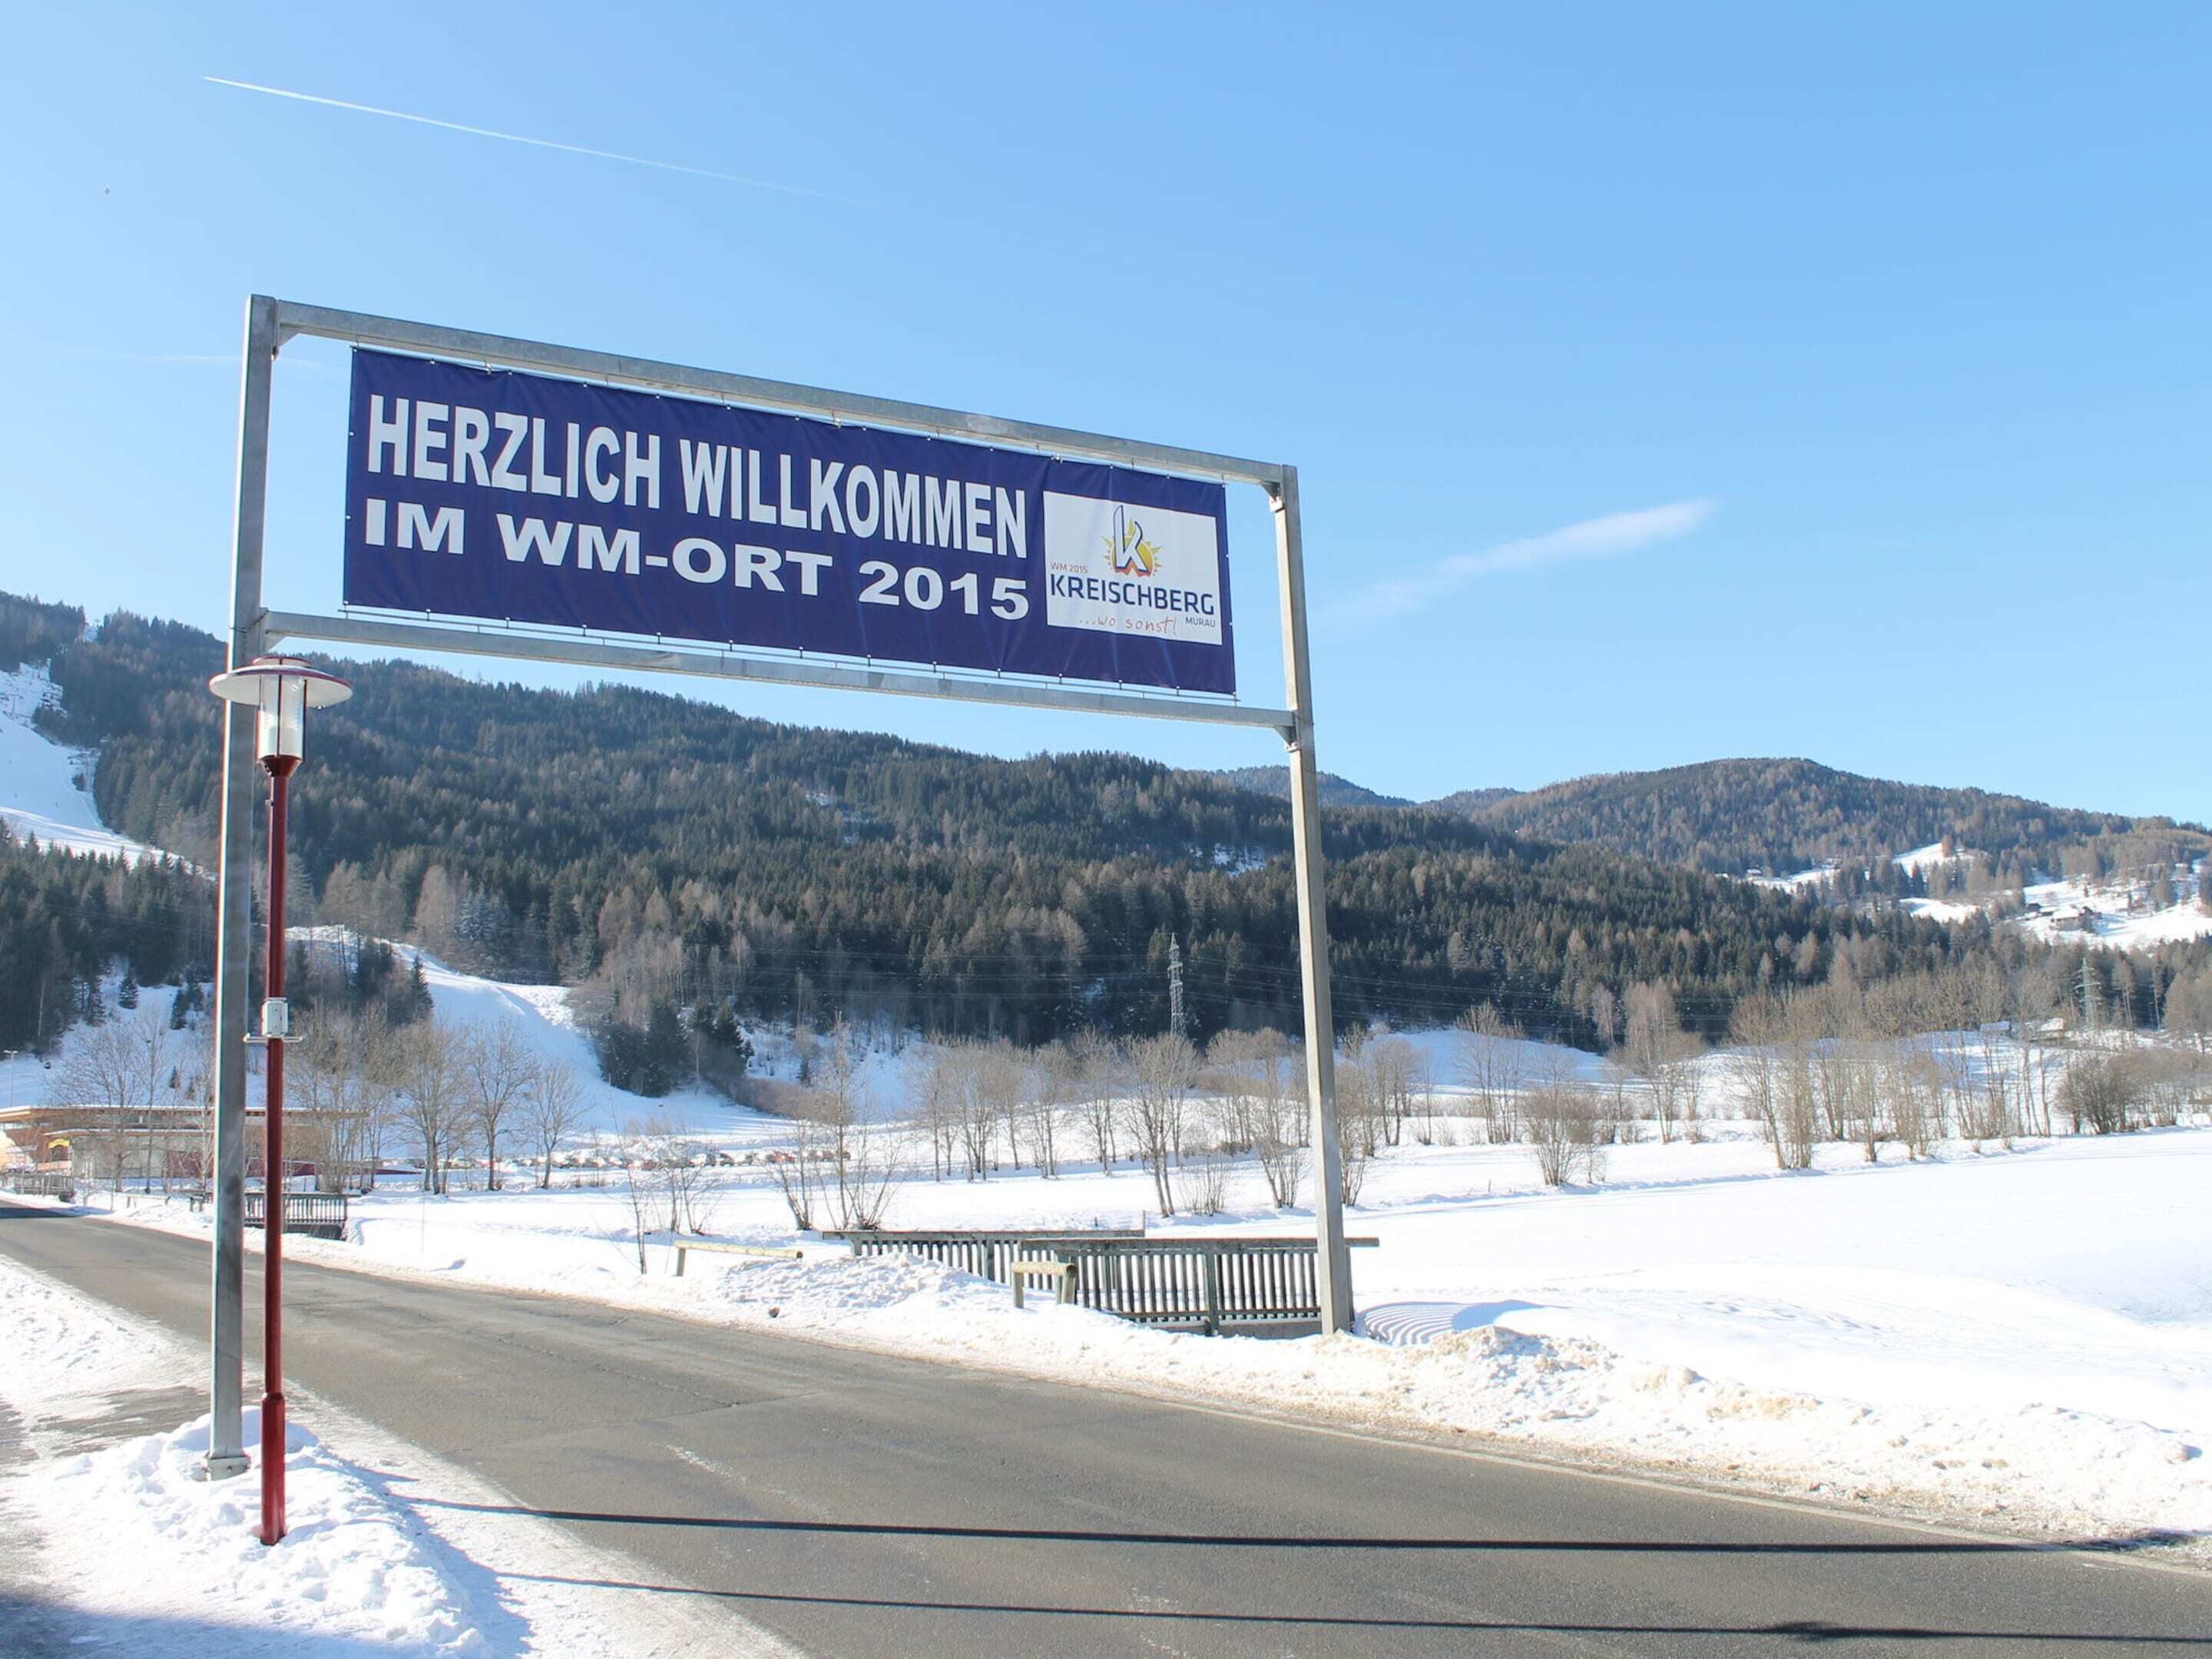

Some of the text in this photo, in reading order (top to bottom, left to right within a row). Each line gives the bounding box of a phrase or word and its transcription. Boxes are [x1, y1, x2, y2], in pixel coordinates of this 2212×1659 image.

[367, 394, 1027, 559] HERZLICH WILLKOMMEN
[365, 498, 1030, 621] IM WM-ORT 2015
[1050, 561, 1088, 574] WM 2015
[1050, 574, 1215, 615] KREISCHBERG
[1125, 615, 1177, 636] sonst!
[1185, 617, 1216, 628] MURAU
